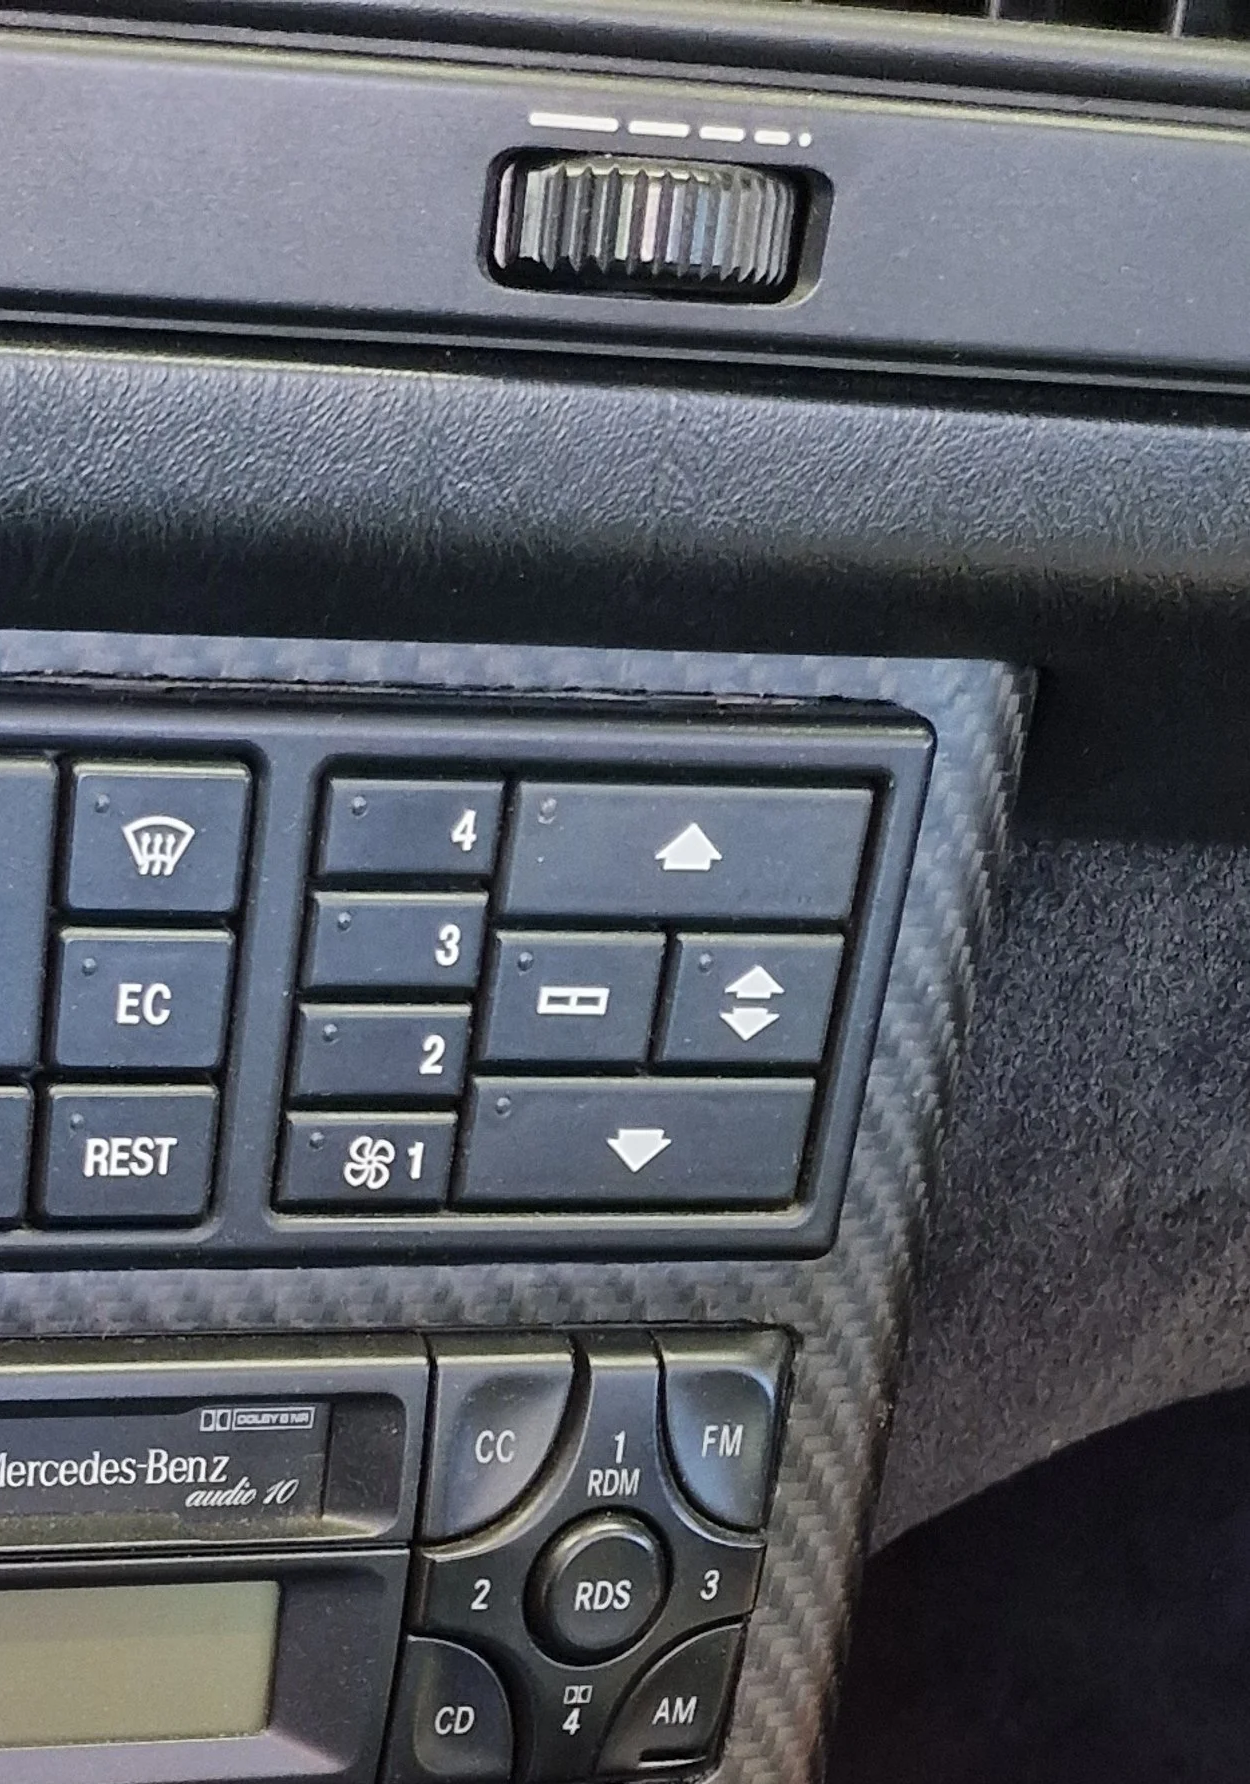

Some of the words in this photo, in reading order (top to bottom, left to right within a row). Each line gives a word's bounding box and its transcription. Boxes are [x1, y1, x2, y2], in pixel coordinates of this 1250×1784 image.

[451, 808, 478, 852] 4
[434, 924, 461, 967] 3
[115, 982, 173, 1027] EC
[419, 1034, 446, 1075] 2
[83, 1136, 178, 1178] REST
[407, 1141, 425, 1180] 1
[237, 1413, 278, 1425] DOLBY
[290, 1412, 310, 1424] NR
[475, 1429, 516, 1464] CC
[612, 1429, 627, 1463] 1
[701, 1424, 743, 1458] FM
[185, 1476, 258, 1508] audio
[262, 1478, 300, 1505] 10
[587, 1468, 641, 1498] RDM
[470, 1578, 492, 1611] 2
[573, 1578, 633, 1612] RDS
[699, 1569, 721, 1601] 3
[434, 1706, 476, 1736] CD
[561, 1707, 582, 1736] 4
[652, 1696, 698, 1726] AM
